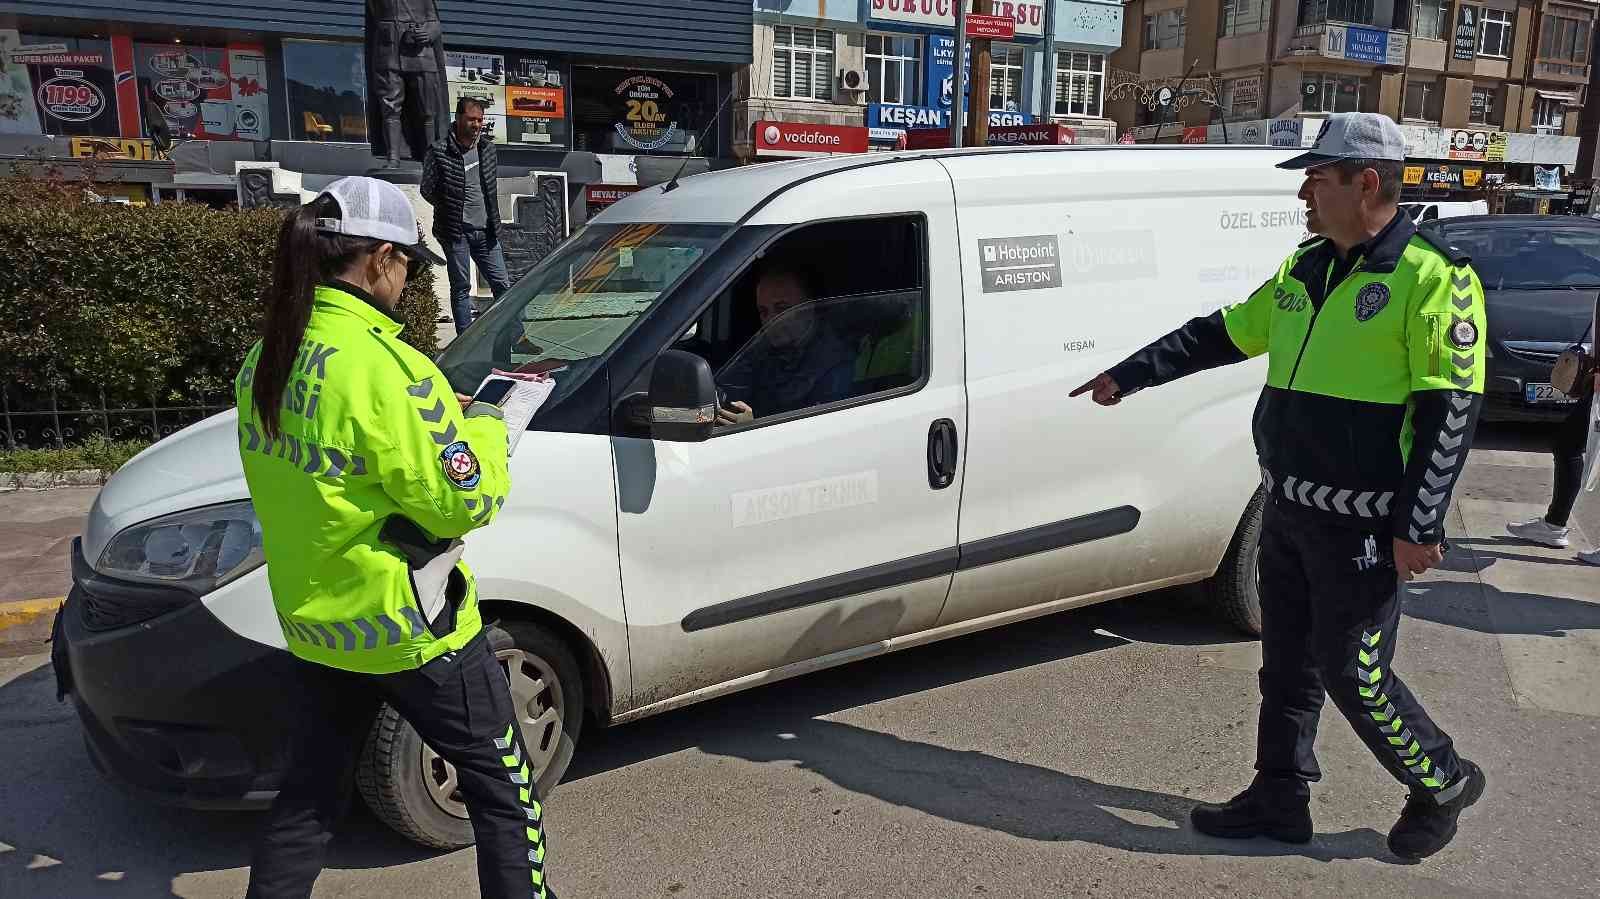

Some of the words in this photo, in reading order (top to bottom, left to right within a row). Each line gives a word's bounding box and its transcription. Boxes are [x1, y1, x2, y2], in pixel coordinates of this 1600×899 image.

[46, 84, 91, 105] 1199
[626, 100, 659, 121] 20
[655, 113, 666, 122] AY
[880, 106, 941, 128] KEŞAN
[987, 113, 1024, 127] SGB
[784, 131, 840, 145] vodafone
[988, 131, 1049, 142] AKBANK
[591, 190, 617, 199] BEYAZ
[1219, 209, 1257, 230] ÖZEL
[998, 242, 1055, 263] Hotpoint
[994, 271, 1052, 286] ARISTON
[1063, 339, 1096, 353] KEŞAN
[1536, 386, 1554, 400] 22
